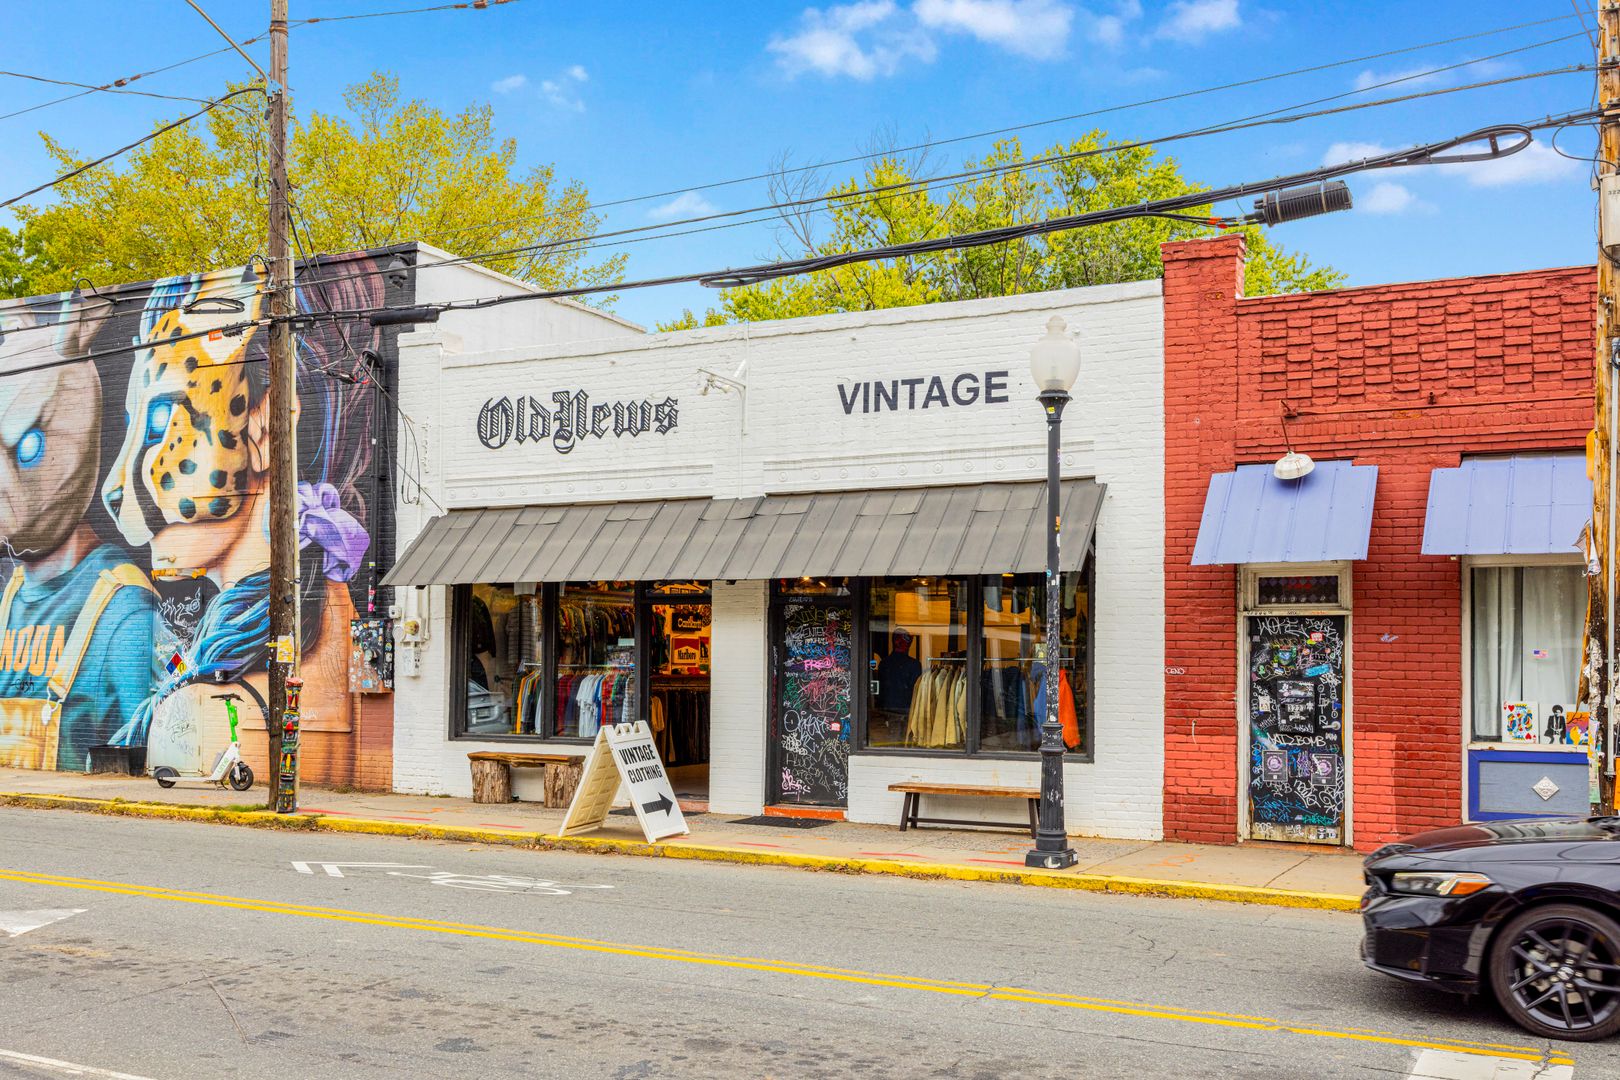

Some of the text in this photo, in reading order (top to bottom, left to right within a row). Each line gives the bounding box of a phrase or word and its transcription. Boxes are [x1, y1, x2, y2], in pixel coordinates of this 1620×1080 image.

[837, 370, 1008, 415] VINTAGE
[618, 744, 656, 765] VINTAGE
[627, 764, 663, 784] CLOTHING
